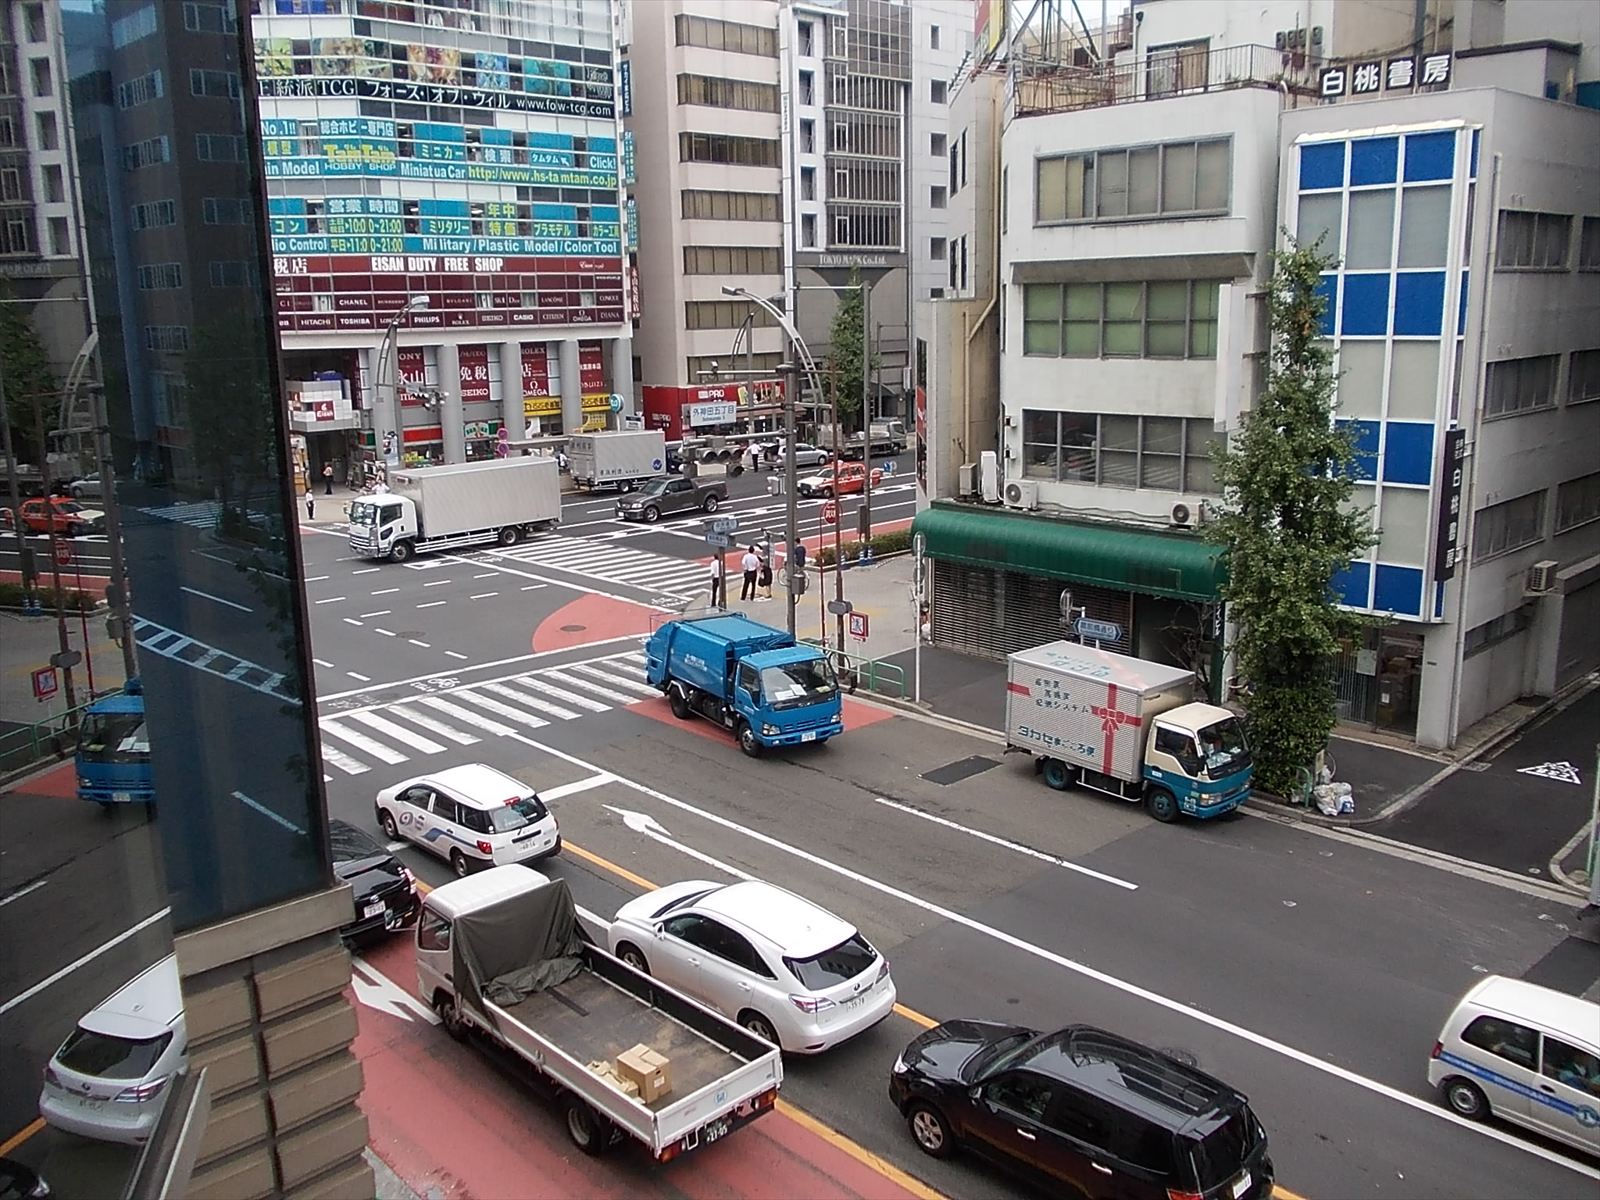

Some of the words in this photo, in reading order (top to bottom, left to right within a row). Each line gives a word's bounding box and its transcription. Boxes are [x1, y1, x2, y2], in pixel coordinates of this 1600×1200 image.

[1322, 54, 1450, 95] 白桃書房
[516, 97, 612, 116] www.fow-tcg.com
[421, 144, 464, 159] ミニカー
[282, 161, 320, 175] Model
[324, 162, 362, 170] HOBBY
[368, 162, 397, 171] SHOP
[589, 156, 616, 170] Click!
[329, 199, 399, 213] 営業時間
[429, 220, 470, 234] ミリタリー
[533, 223, 572, 237] プラモデル
[289, 238, 327, 252] Control
[593, 242, 617, 253] Tool
[371, 256, 405, 271] EISAN
[407, 256, 437, 271] DUTY
[443, 257, 469, 271] FREE
[474, 257, 504, 271] SHOP
[300, 318, 331, 326] HITACHI
[414, 315, 440, 323] PHILIPS
[460, 365, 488, 381] 免税
[461, 388, 489, 397] SEIKO
[522, 387, 548, 396] OMEGA
[708, 389, 725, 398] PRO
[692, 405, 735, 417] 外神田五丁目
